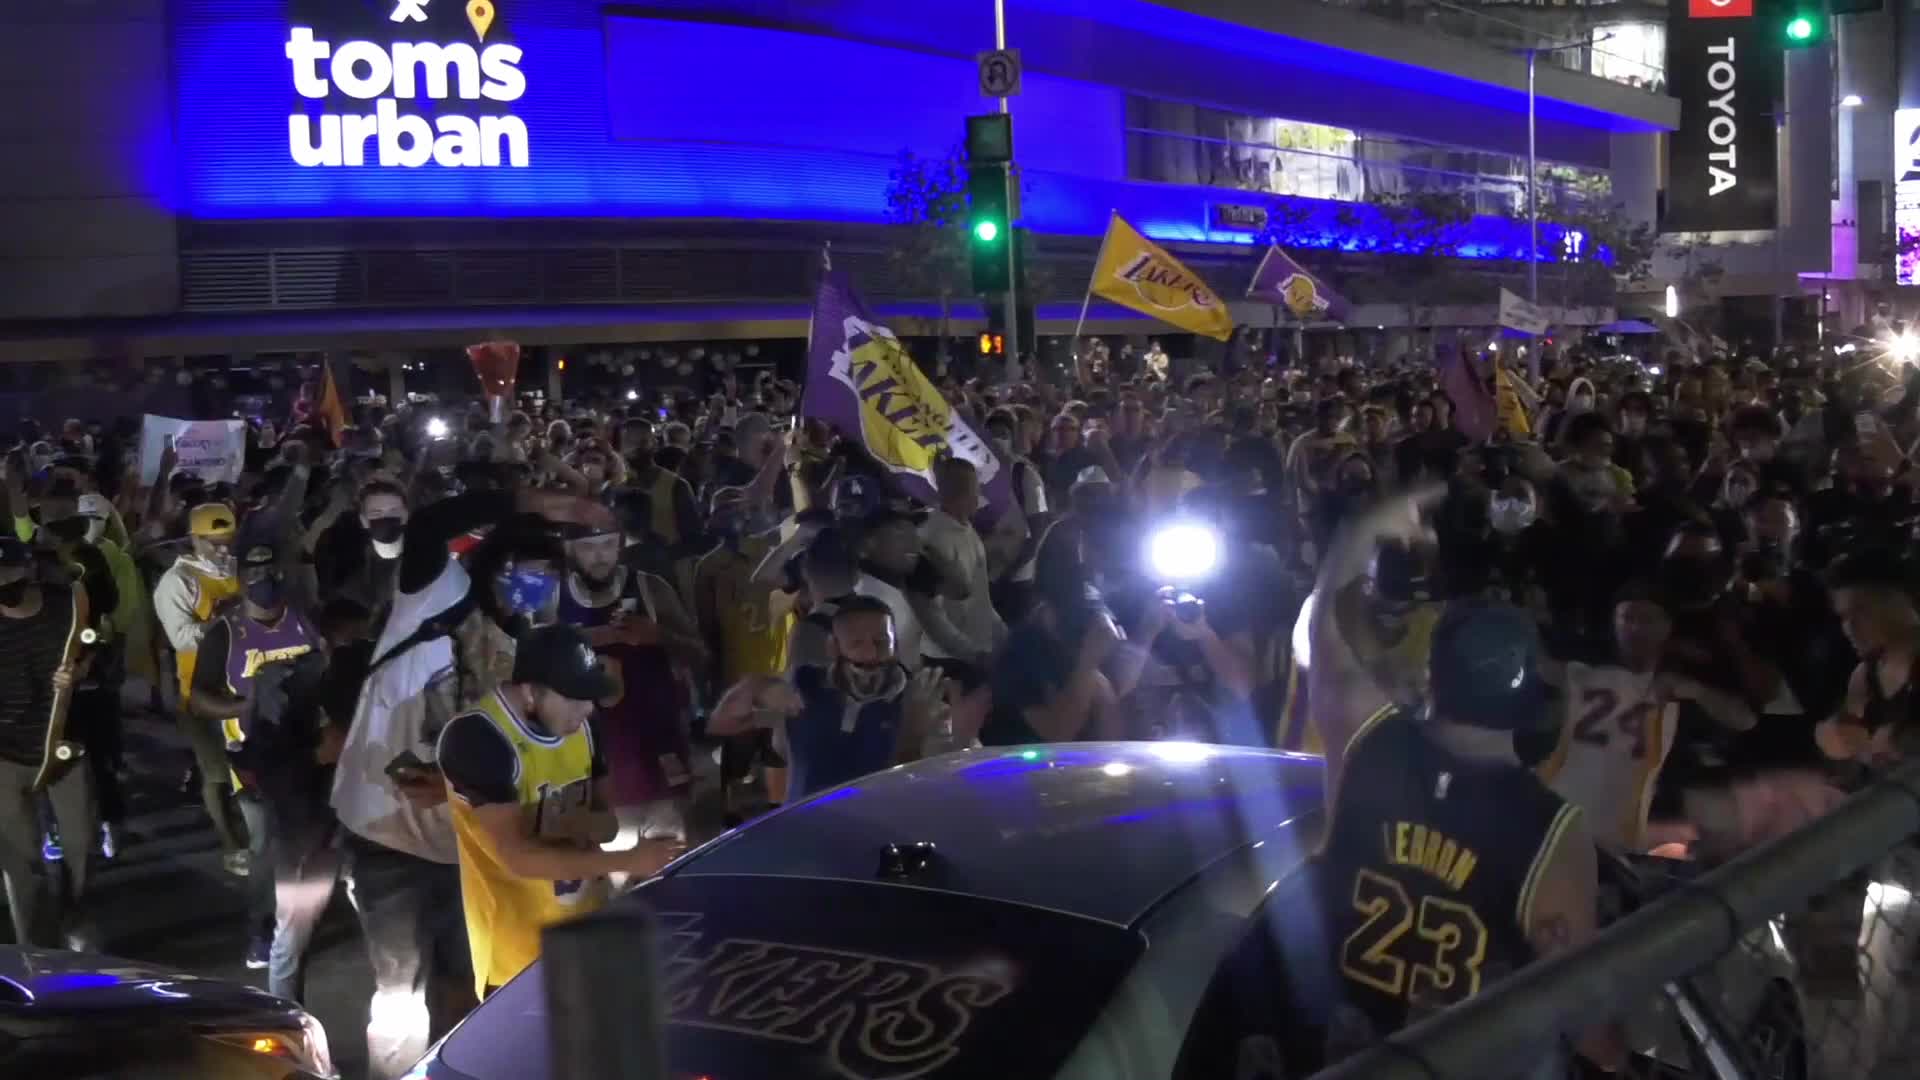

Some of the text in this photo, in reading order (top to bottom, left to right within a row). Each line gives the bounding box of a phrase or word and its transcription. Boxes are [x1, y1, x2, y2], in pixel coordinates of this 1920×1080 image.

[285, 27, 526, 101] toms
[1707, 37, 1737, 196] TOYOTA
[288, 98, 529, 168] urban
[1341, 866, 1489, 1008] 23
